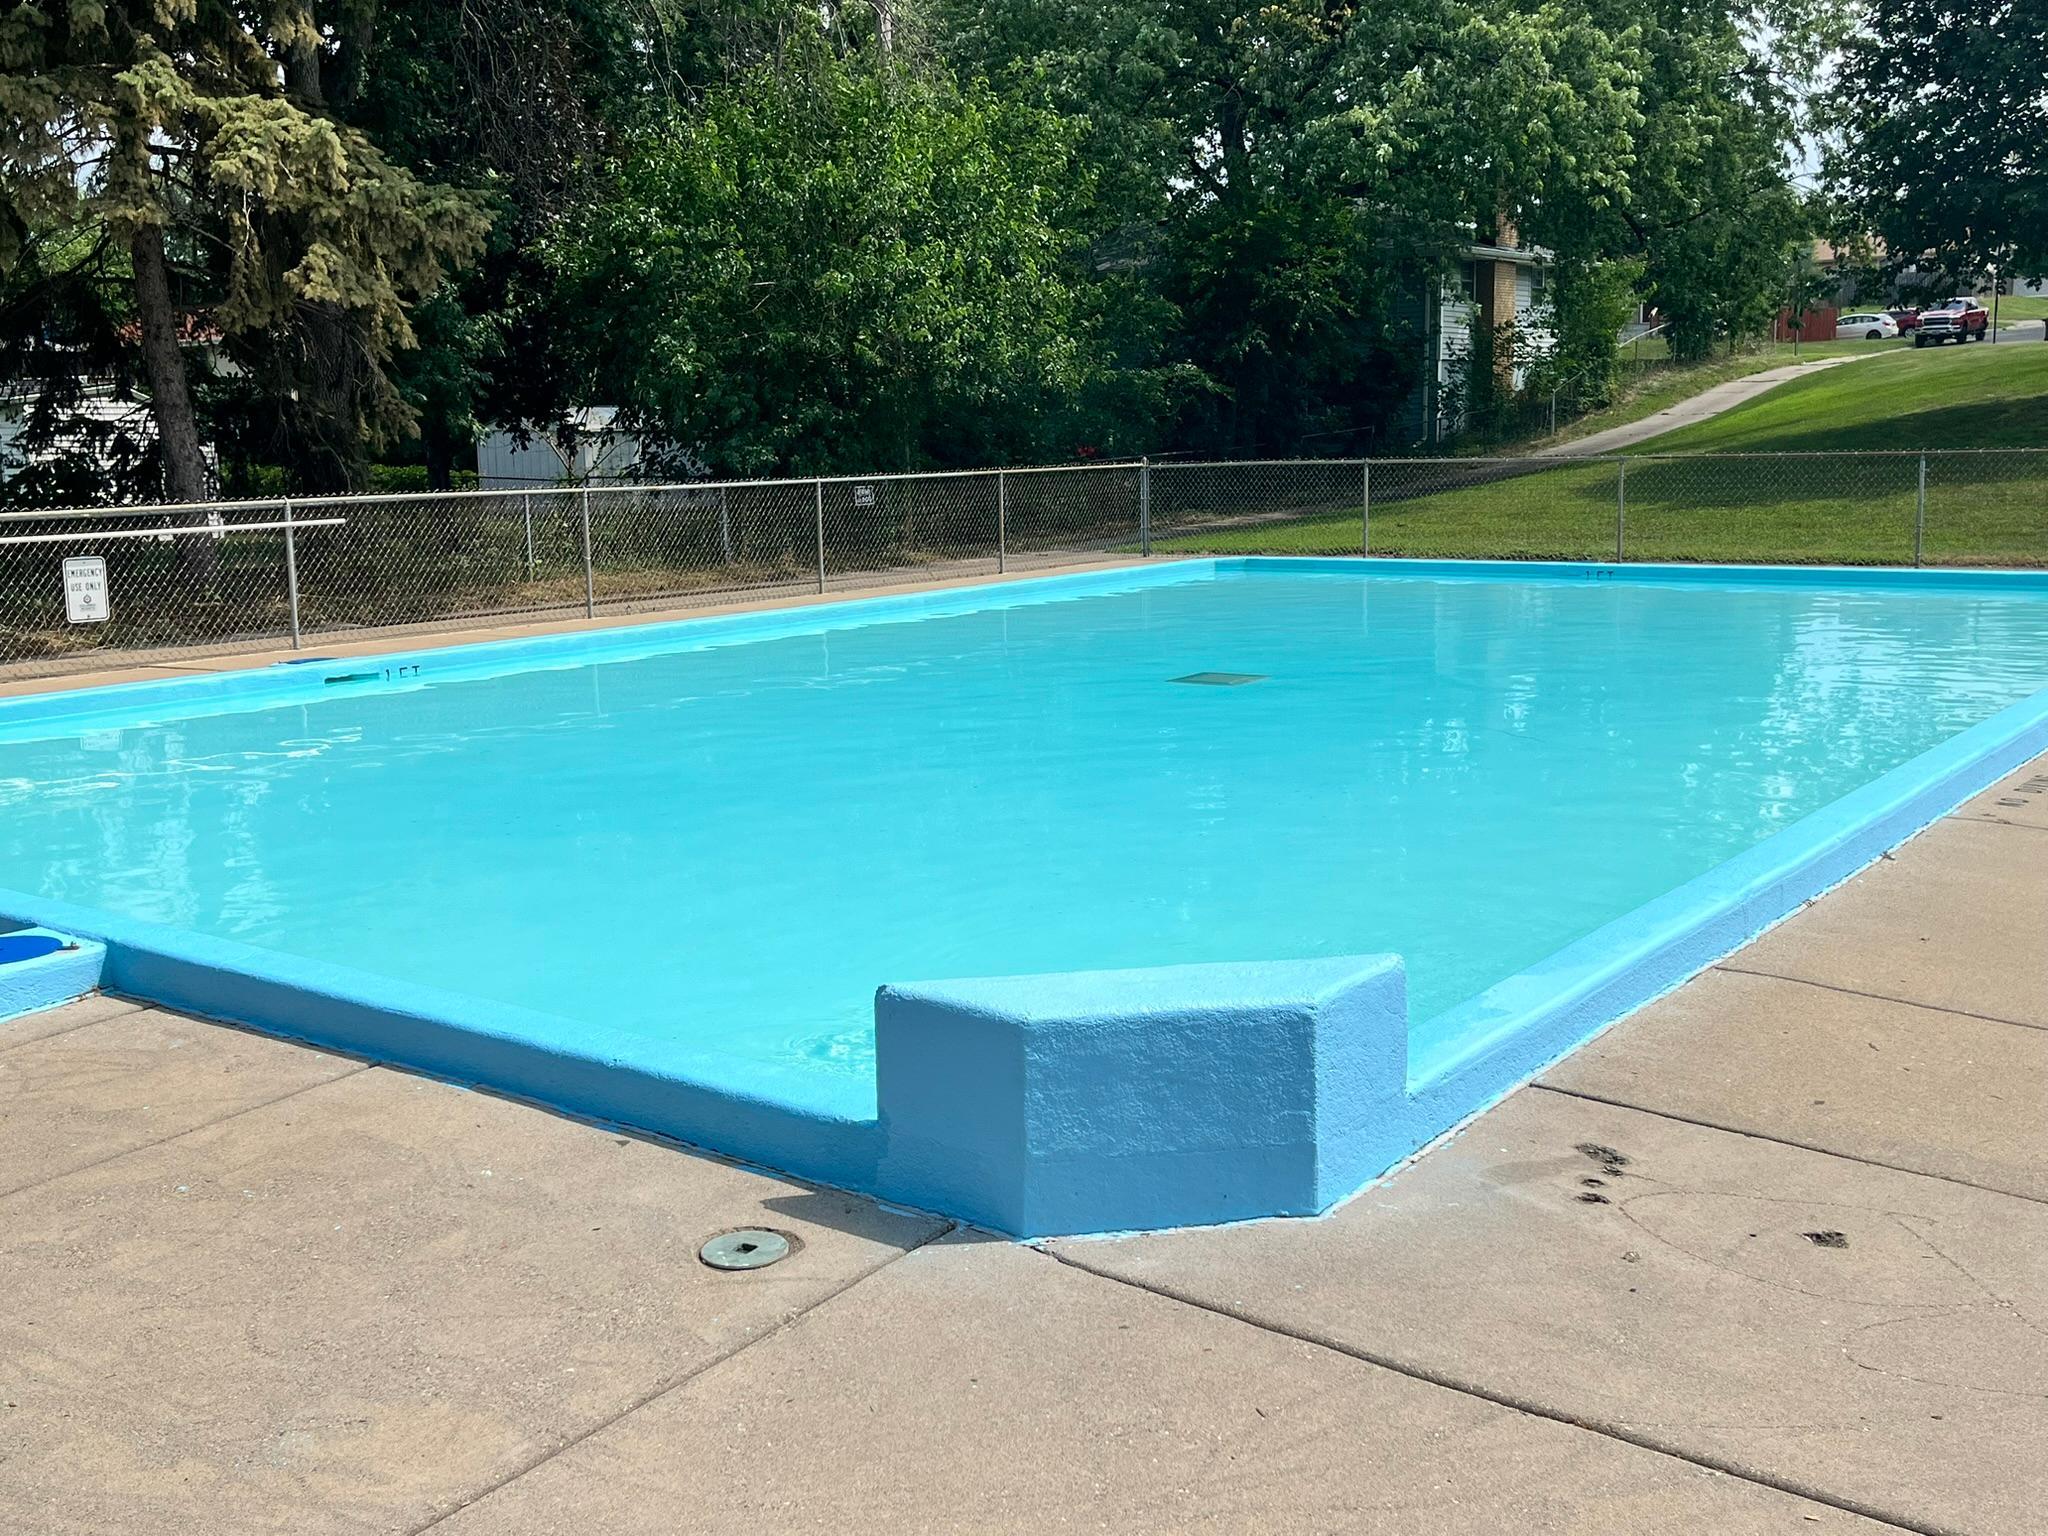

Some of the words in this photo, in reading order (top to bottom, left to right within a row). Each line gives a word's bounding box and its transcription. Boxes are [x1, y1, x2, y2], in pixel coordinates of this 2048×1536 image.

[67, 568, 102, 578] EMERGENCY
[71, 582, 82, 592] USE
[85, 582, 101, 591] ONLY
